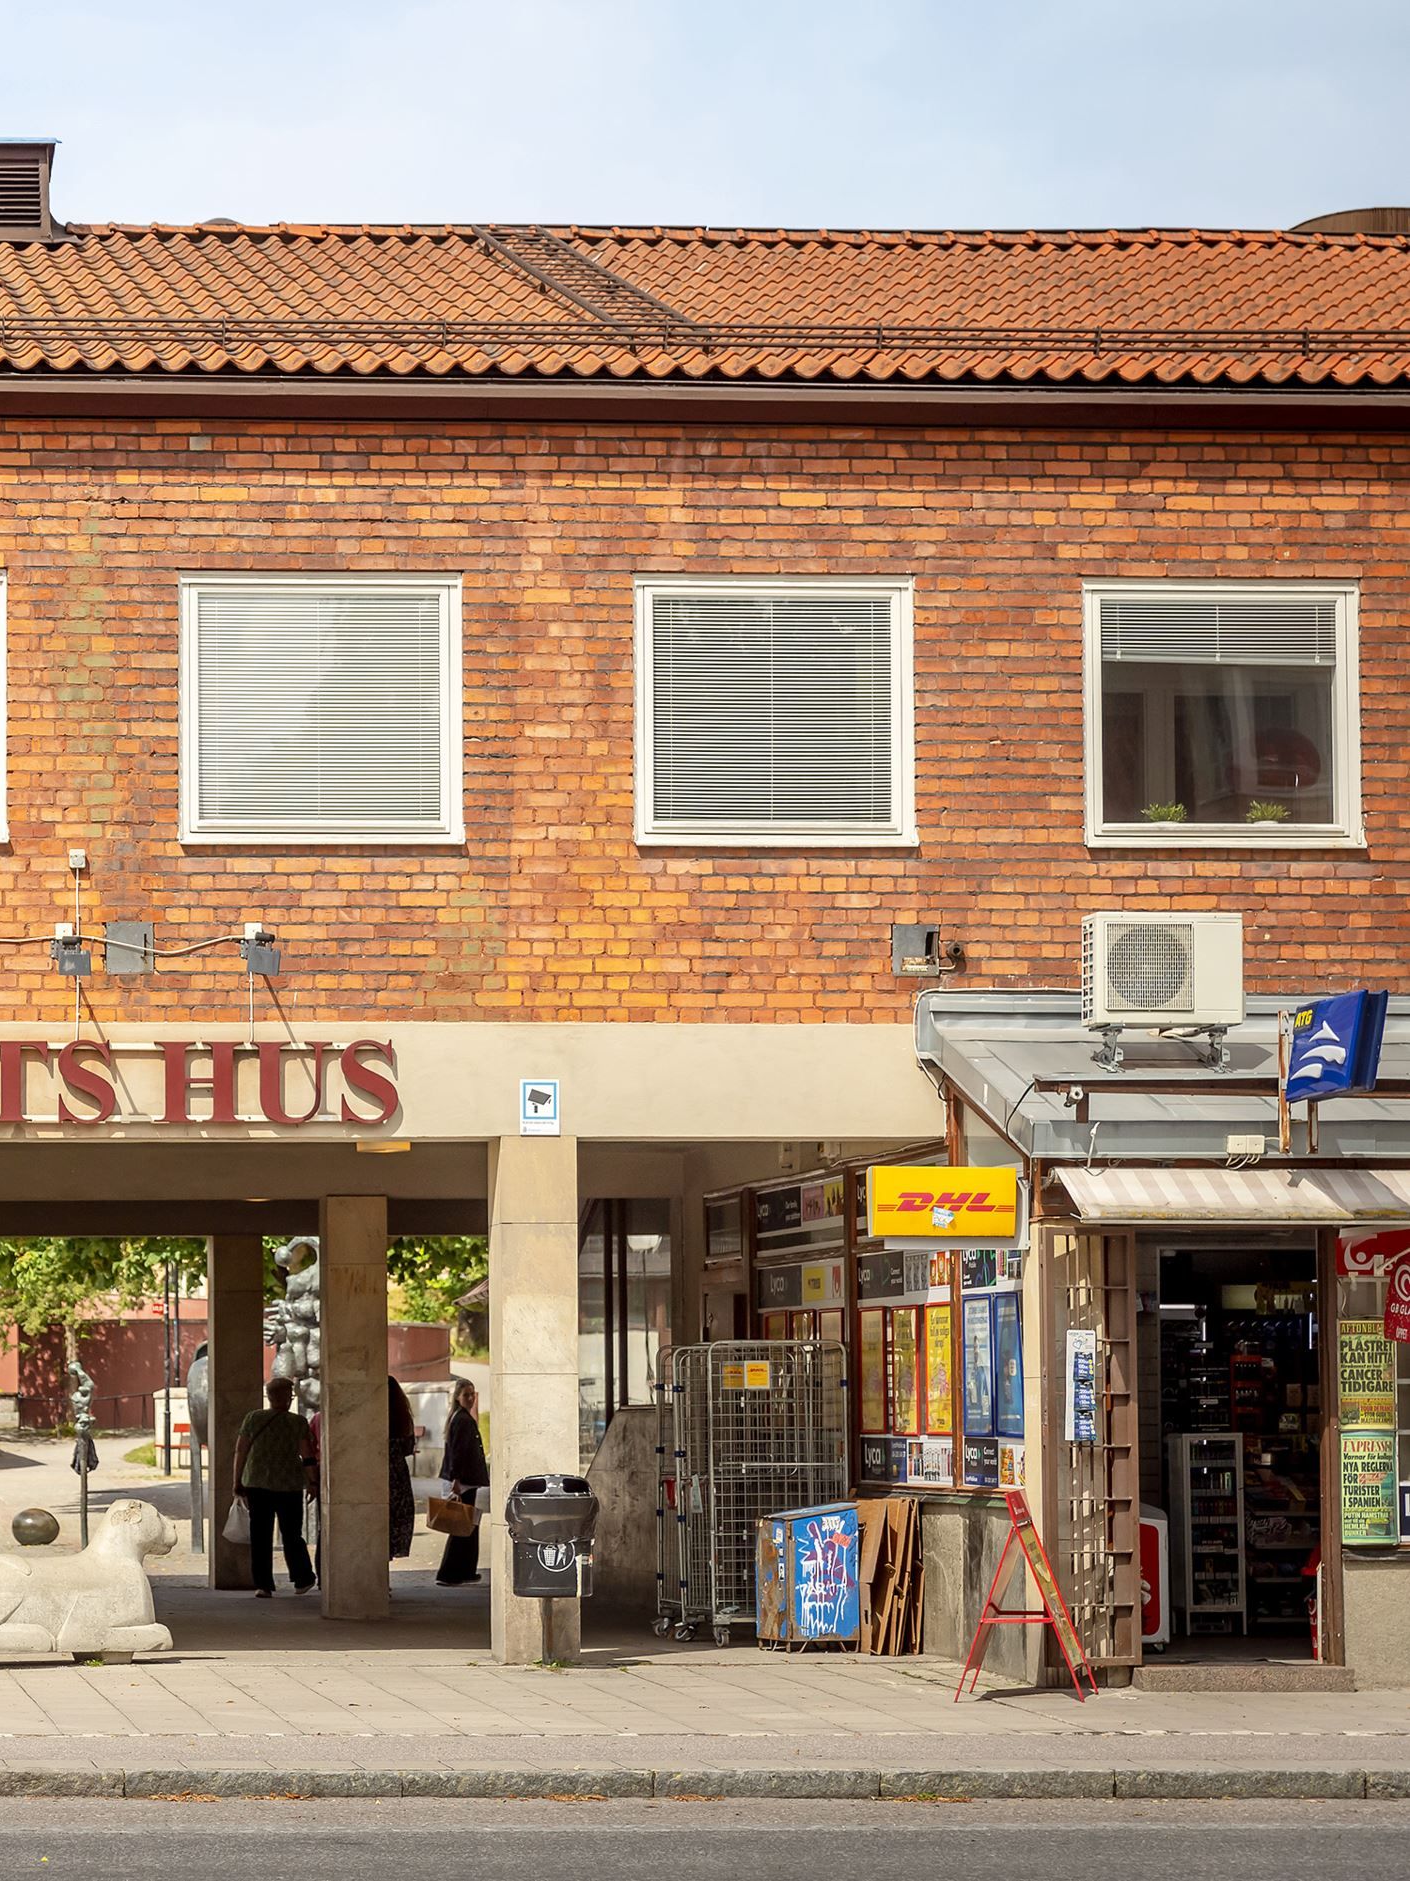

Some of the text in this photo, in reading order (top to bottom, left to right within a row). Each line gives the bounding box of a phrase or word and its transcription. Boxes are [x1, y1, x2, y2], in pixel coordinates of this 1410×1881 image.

[1294, 1009, 1313, 1028] ATG
[154, 1038, 399, 1125] HUS
[856, 1184, 866, 1203] Lyc
[896, 1192, 997, 1212] DHL
[1390, 1303, 1399, 1314] GB
[1341, 1352, 1393, 1364] KAN HITTA
[1341, 1369, 1383, 1380] CANCER
[1341, 1381, 1393, 1392] TIDIGARE
[864, 1443, 881, 1468] Lyca
[965, 1444, 977, 1463] Lyca
[1343, 1462, 1359, 1472] NYA
[1343, 1473, 1358, 1484] FÖR
[1343, 1485, 1380, 1496] TURISTER
[1343, 1497, 1381, 1507] I SPANIEN
